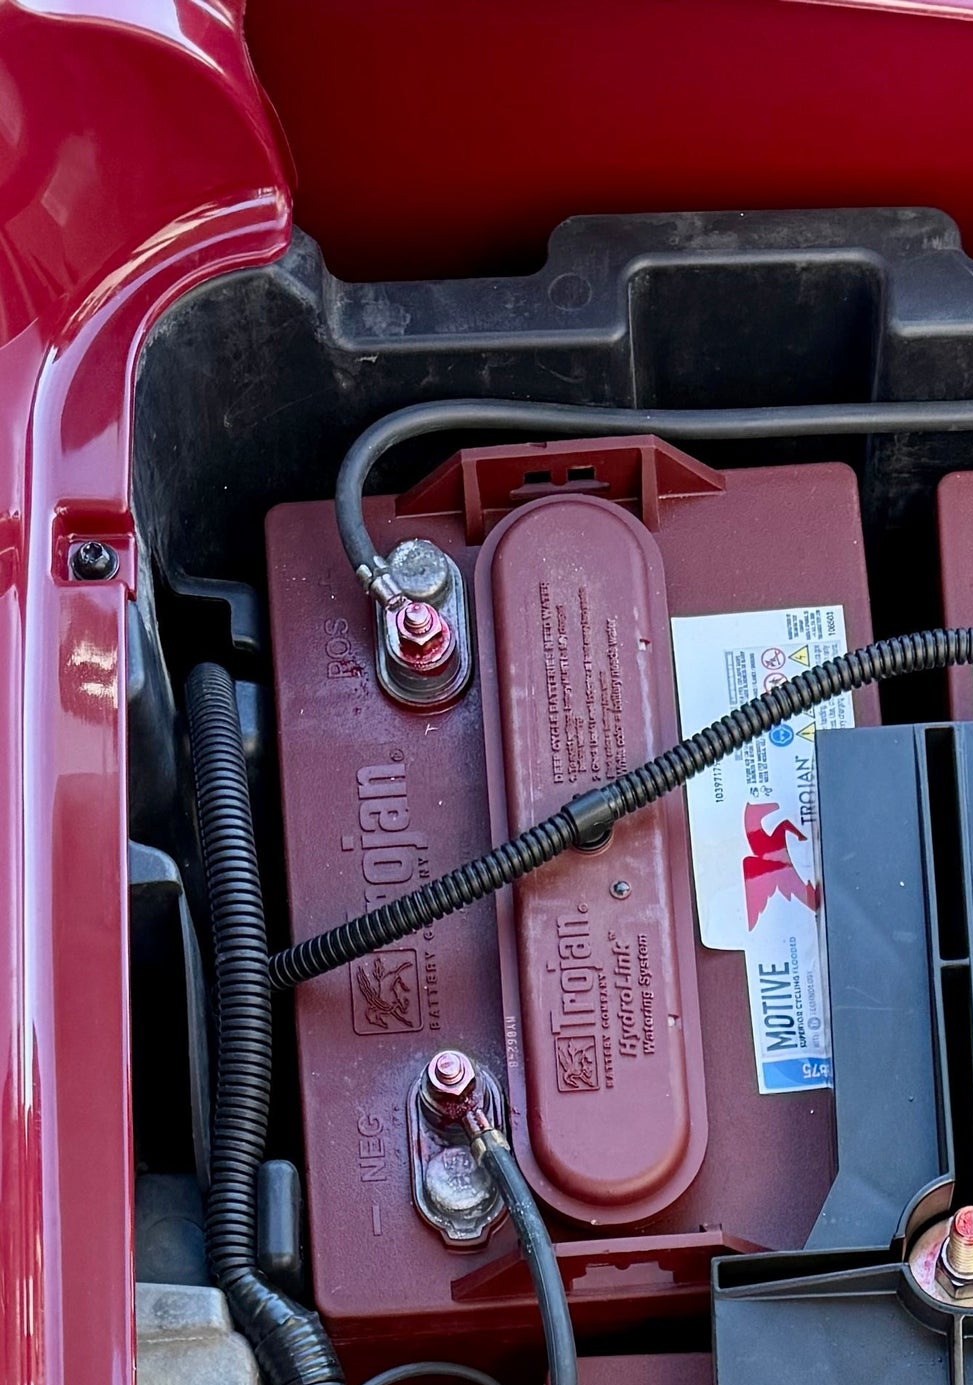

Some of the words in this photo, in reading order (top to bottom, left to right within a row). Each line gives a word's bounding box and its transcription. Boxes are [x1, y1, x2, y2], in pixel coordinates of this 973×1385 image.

[323, 617, 353, 679] POS
[796, 759, 816, 825] TROJAN
[424, 951, 441, 1031] BATTERY
[637, 933, 652, 986] System
[598, 974, 609, 1029] COMPANY
[640, 991, 656, 1055] Watering
[759, 962, 798, 1052] MOTIVE
[793, 975, 803, 1009] CYCLING
[602, 1036, 614, 1088] BATTERY
[358, 1113, 387, 1183] NEG
